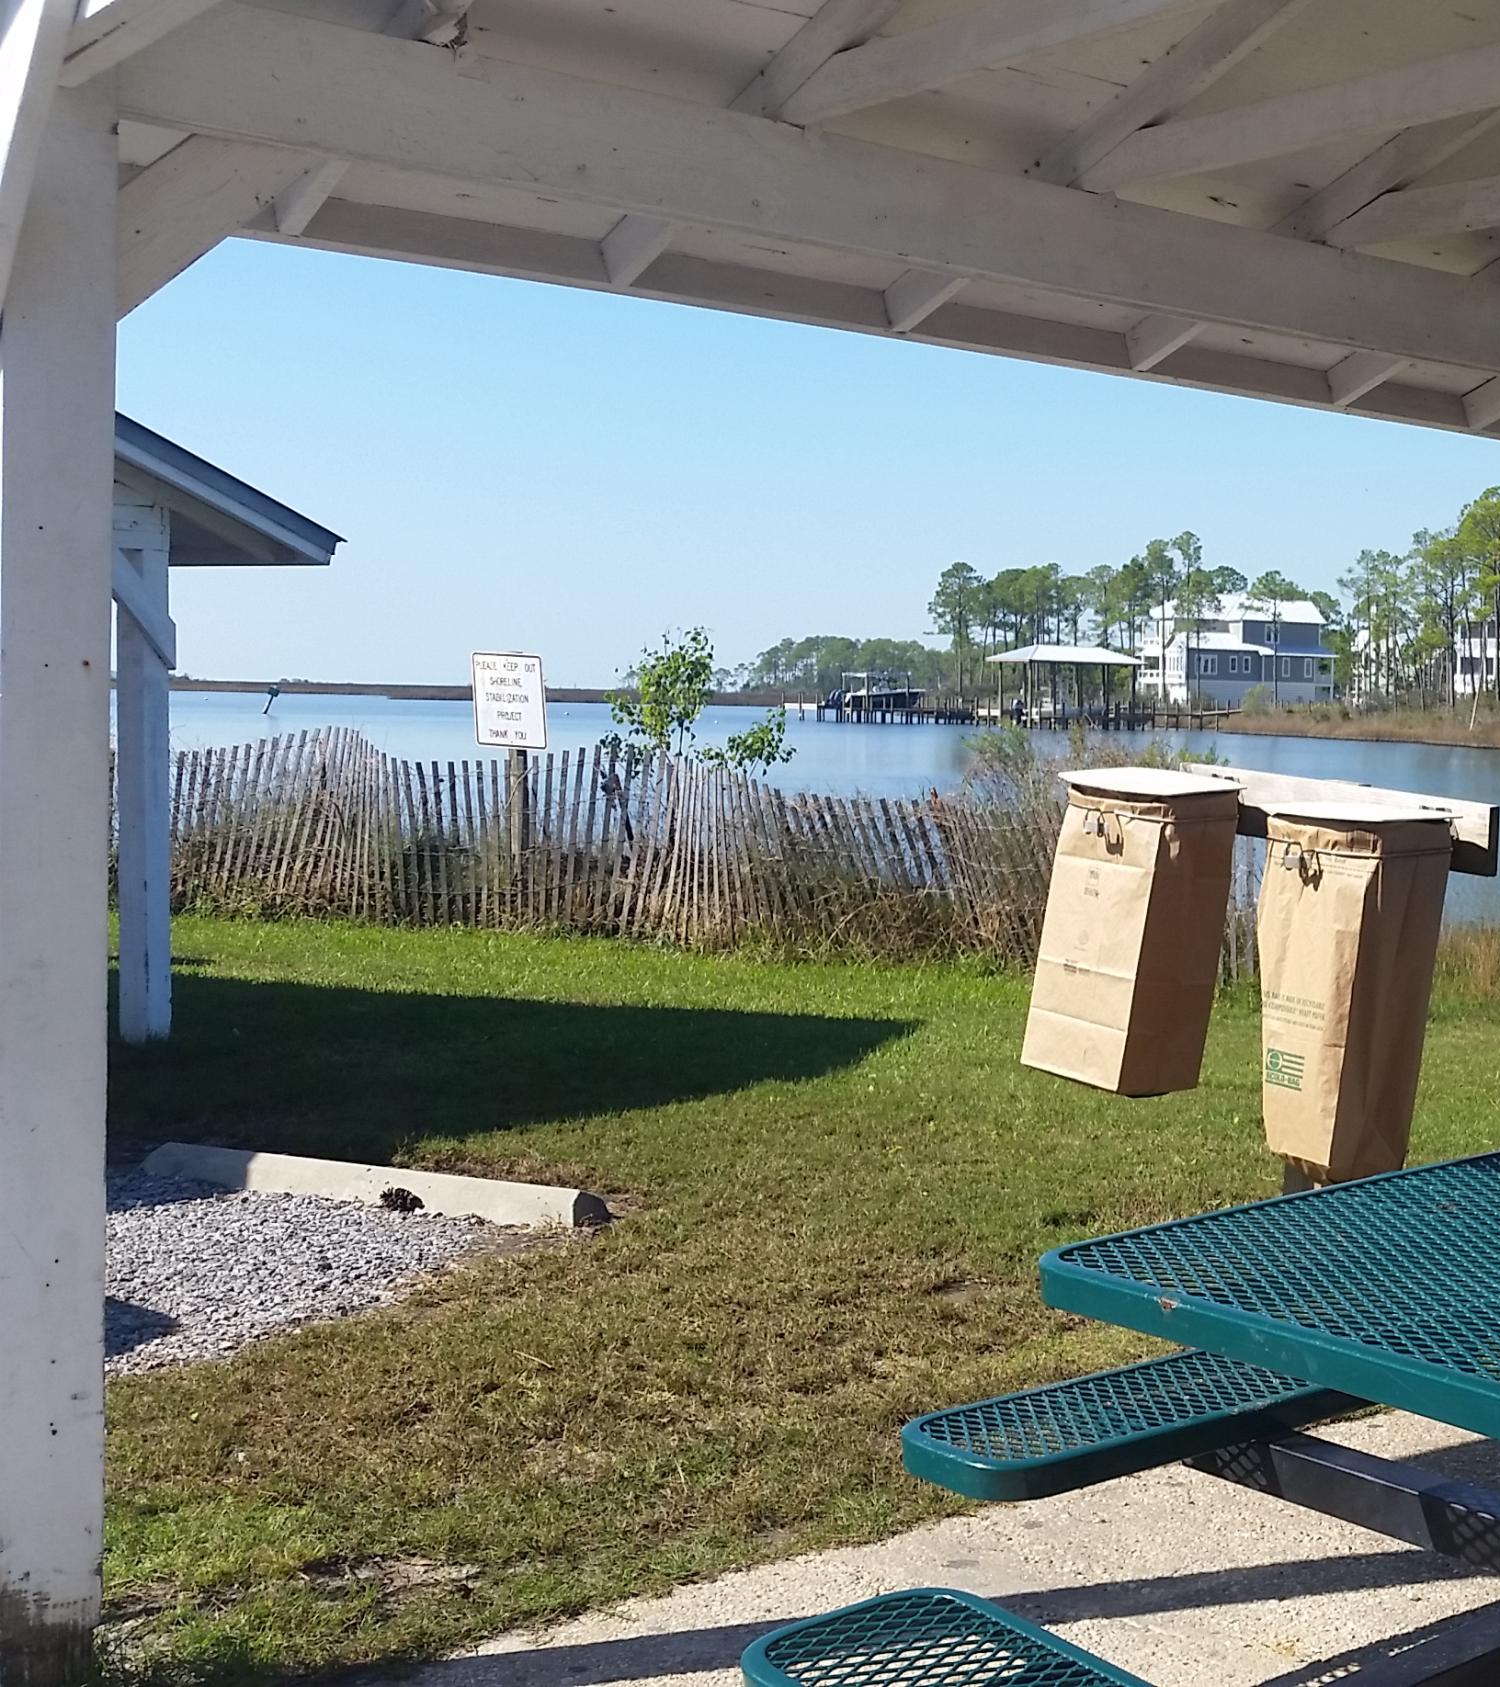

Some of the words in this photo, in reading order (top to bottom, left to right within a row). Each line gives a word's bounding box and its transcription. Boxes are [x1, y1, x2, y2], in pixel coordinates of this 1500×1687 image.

[524, 663, 536, 673] OUT
[489, 676, 522, 688] SHORELINE
[485, 692, 529, 704] STABILIZATION
[496, 710, 522, 721] PROJECT
[488, 728, 508, 739] THANK
[514, 730, 527, 741] YOU
